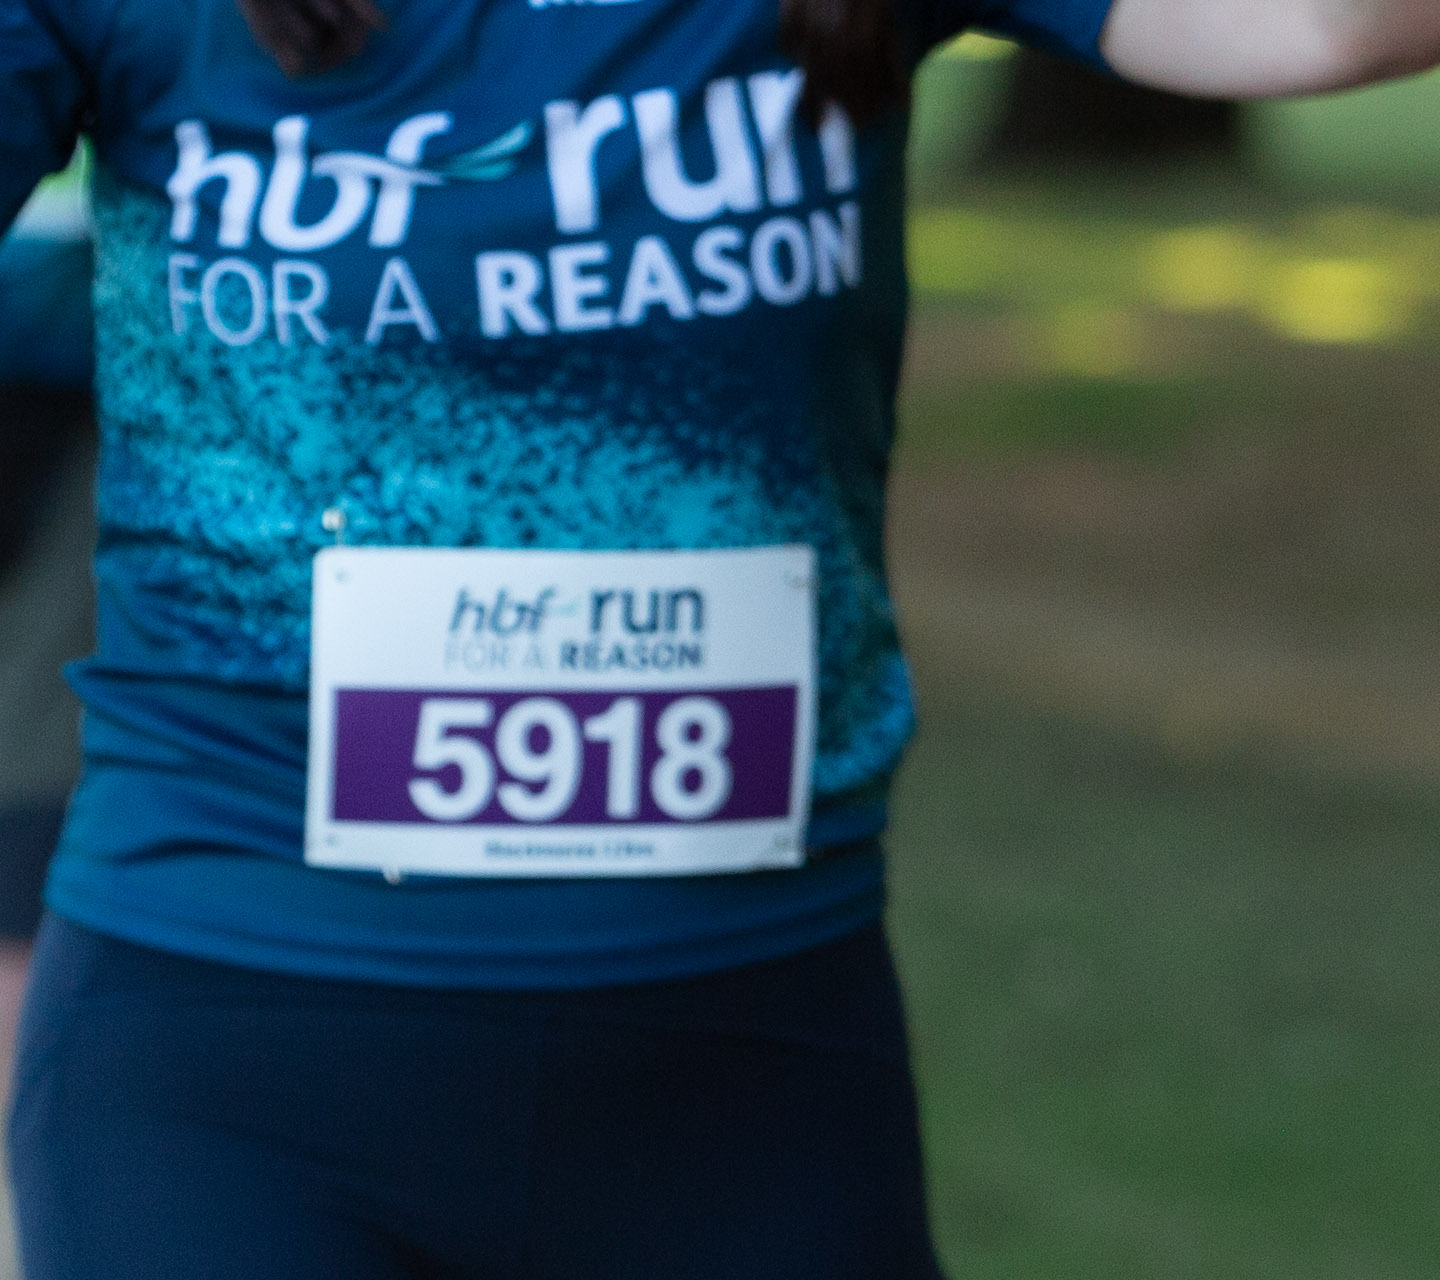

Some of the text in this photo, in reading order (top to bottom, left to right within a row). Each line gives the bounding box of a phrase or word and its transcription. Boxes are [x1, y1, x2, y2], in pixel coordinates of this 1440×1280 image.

[167, 68, 857, 251] hbf run
[167, 200, 862, 347] FOR A REASON
[448, 586, 706, 637] hbf run
[560, 640, 703, 671] REASON
[408, 696, 733, 822] 5918
